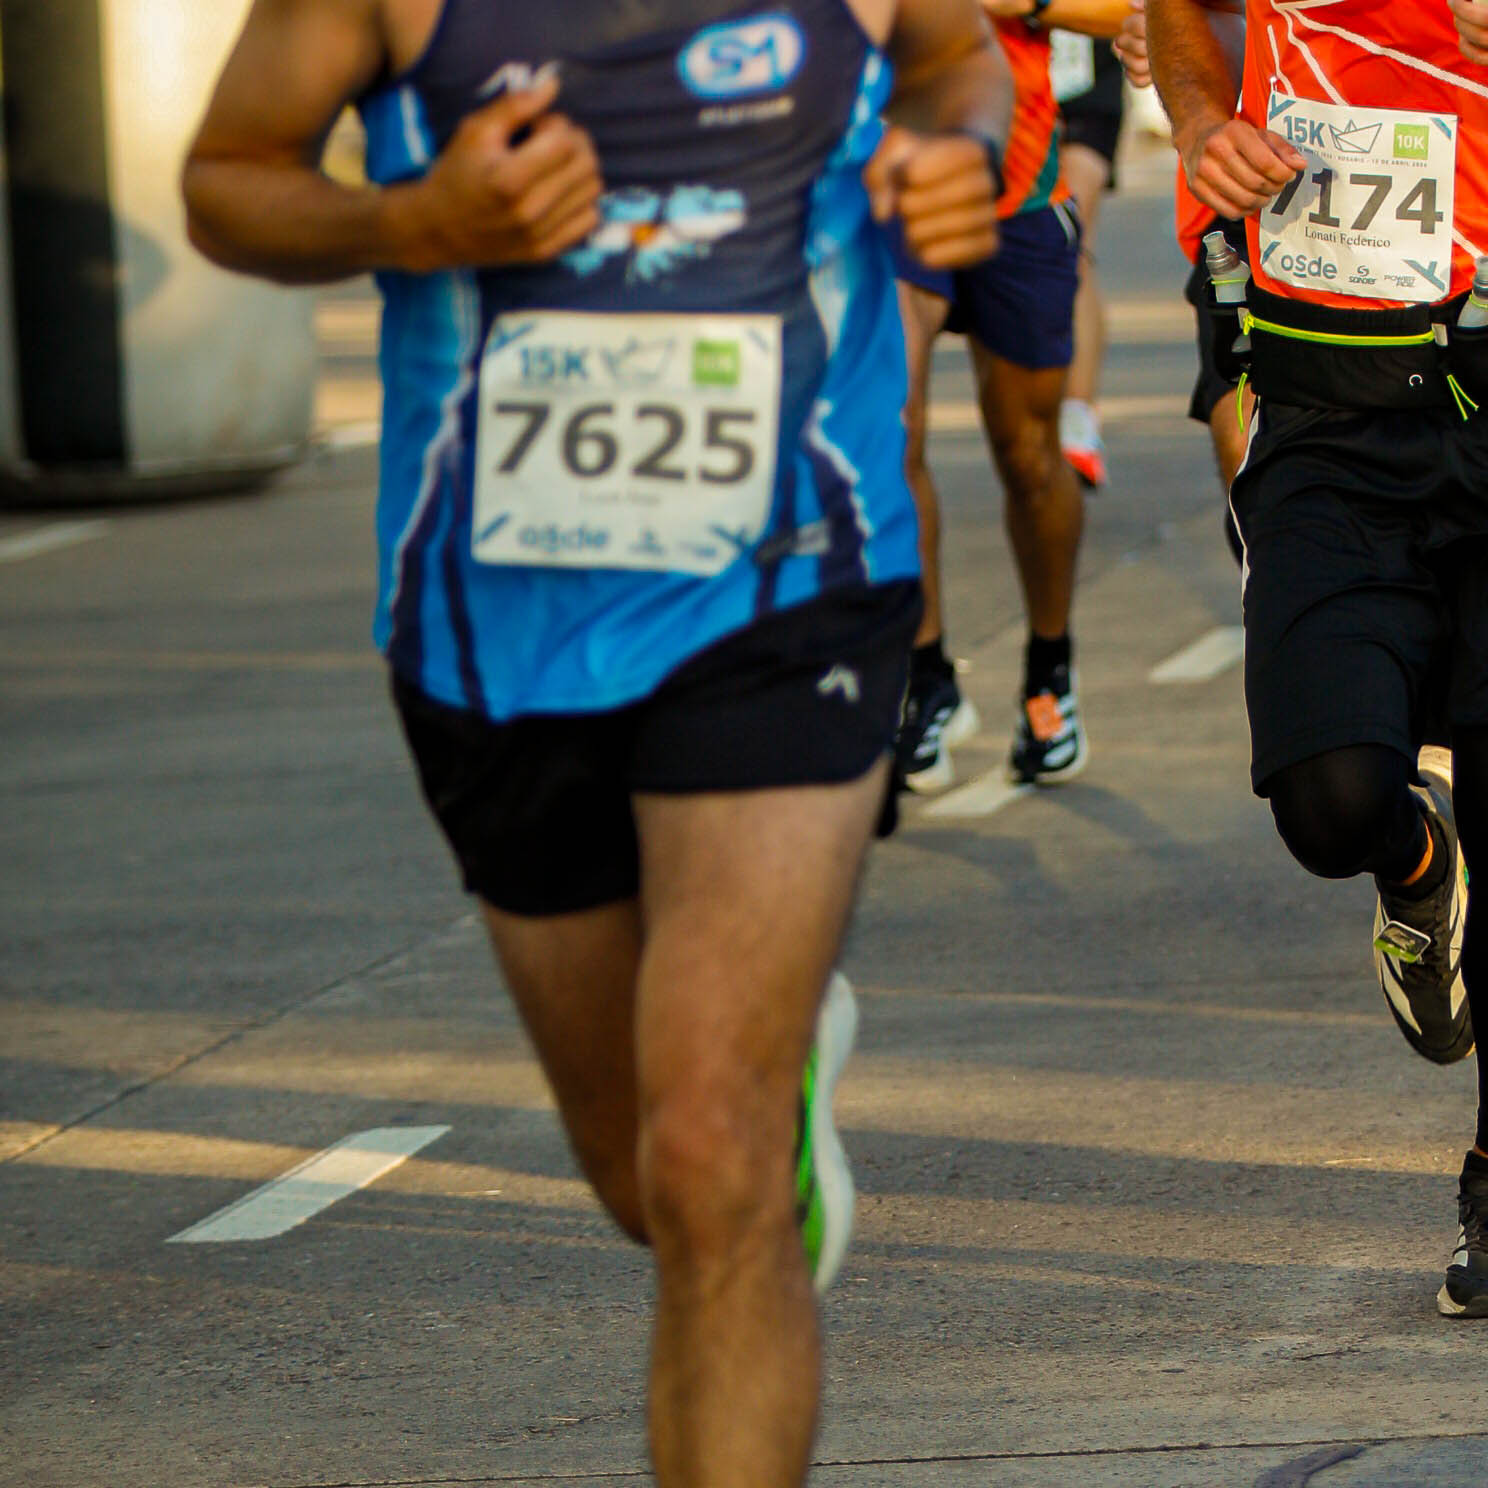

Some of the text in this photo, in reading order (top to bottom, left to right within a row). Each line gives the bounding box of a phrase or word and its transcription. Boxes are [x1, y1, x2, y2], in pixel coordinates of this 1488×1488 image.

[1283, 114, 1326, 149] 15K
[1396, 134, 1425, 151] 10K
[1304, 226, 1391, 249] Lonati Federico
[1280, 254, 1338, 280] osde
[518, 344, 589, 382] 15K
[493, 402, 757, 486] 7625
